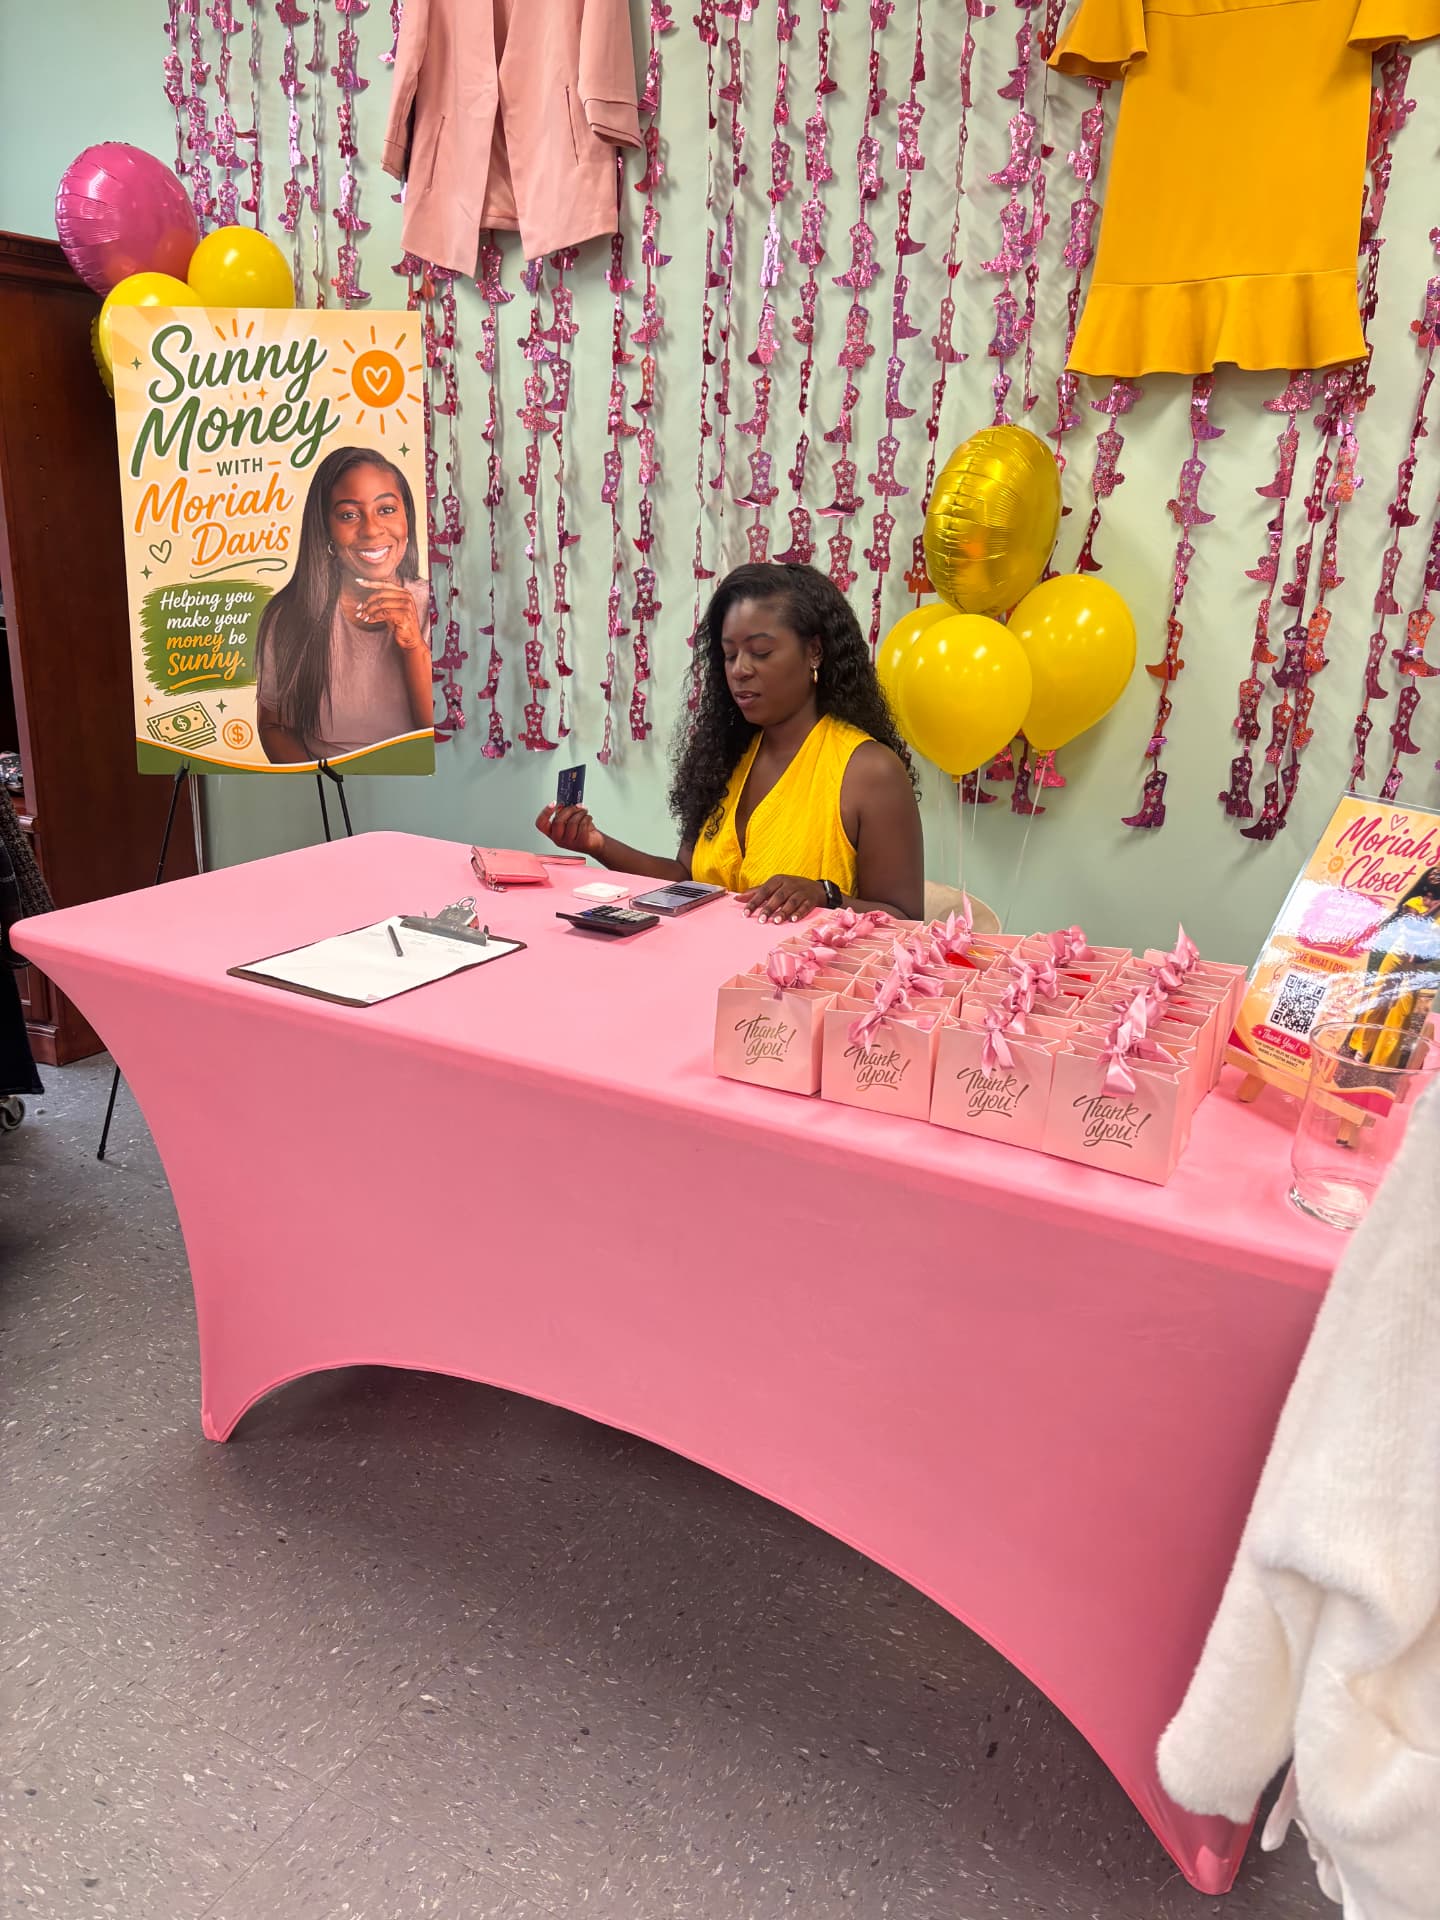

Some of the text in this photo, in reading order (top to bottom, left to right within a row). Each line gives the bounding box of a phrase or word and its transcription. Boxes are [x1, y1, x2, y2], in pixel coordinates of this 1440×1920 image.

[148, 324, 328, 404] Sunny
[130, 396, 341, 478] Money
[216, 457, 263, 477] WITH
[134, 472, 294, 534] Moriah
[191, 521, 291, 566] Davis
[159, 589, 255, 613] Helping you
[166, 610, 251, 633] make your
[166, 628, 247, 653] money be
[1341, 855, 1417, 893] Closet
[735, 1014, 788, 1044] Thank
[1261, 1028, 1300, 1050] Thank You!
[843, 1044, 901, 1072] Thank
[956, 1067, 1018, 1097] Thank
[1073, 1094, 1139, 1126] Thank
